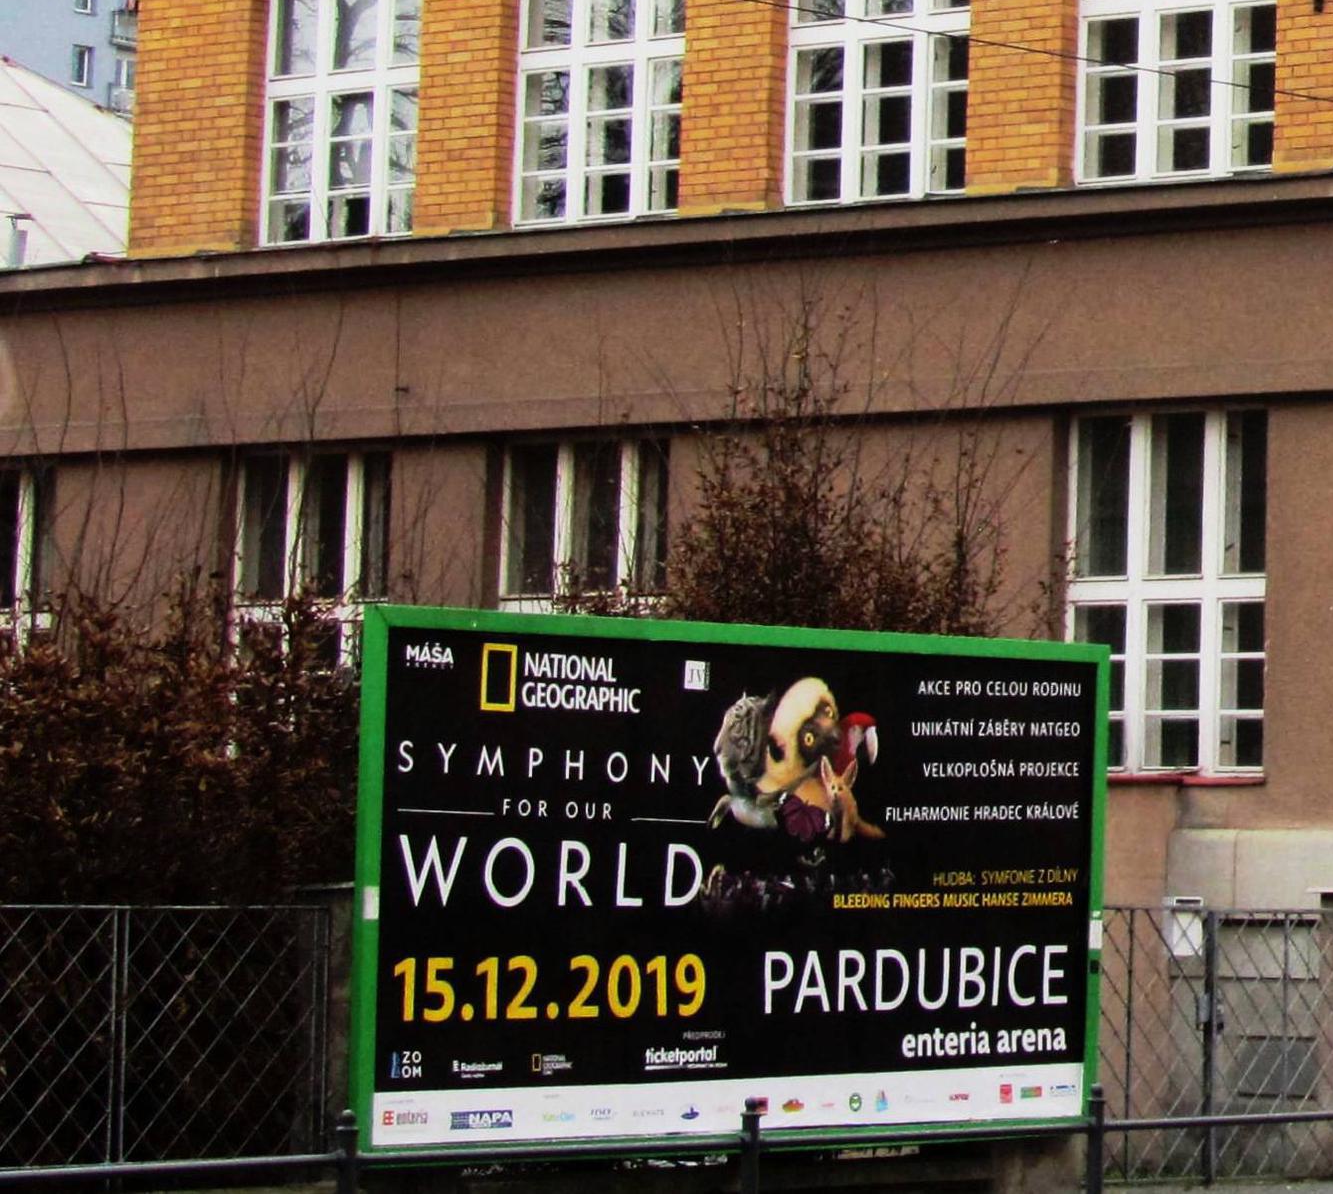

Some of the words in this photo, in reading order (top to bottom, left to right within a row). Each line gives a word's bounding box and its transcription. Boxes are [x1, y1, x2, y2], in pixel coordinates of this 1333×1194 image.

[406, 642, 453, 663] MÁŠA
[525, 652, 616, 683] NATIONAL
[522, 680, 640, 713] GEOGRAPHIC
[919, 681, 950, 695] AKCE
[956, 681, 981, 695] PRO
[987, 681, 1027, 696] CELOU
[1033, 682, 1080, 696] RODINU
[912, 719, 973, 736] UNIKÁTNÍ
[979, 719, 1025, 736] ZÁBĚRY
[1031, 722, 1080, 736] NATGEO
[398, 739, 709, 786] SYMPHONY
[923, 759, 1014, 777] VELKOPLOŠNÁ
[1020, 762, 1078, 776] PROJEKCE
[503, 799, 547, 816] FOR
[566, 802, 611, 819] OUR
[886, 806, 969, 821] FILHARMONIE
[974, 805, 1022, 820] HRADEC
[1027, 802, 1078, 819] KRÁLOVÉ
[399, 834, 703, 907] WORLD
[1038, 869, 1044, 883] Z
[834, 894, 890, 908] BLEEDING
[893, 894, 940, 908] FINGERS
[943, 893, 979, 907] MUSIC
[982, 893, 1018, 906] HANSE
[1022, 892, 1072, 905] ZIMMERA
[394, 954, 705, 1022] 15.12.2019
[765, 945, 1067, 1013] PARDUBICE
[902, 1022, 990, 1057] enteria
[997, 1028, 1066, 1053] arena
[645, 1045, 717, 1065] ticketportal
[469, 1111, 512, 1127] NAPA
